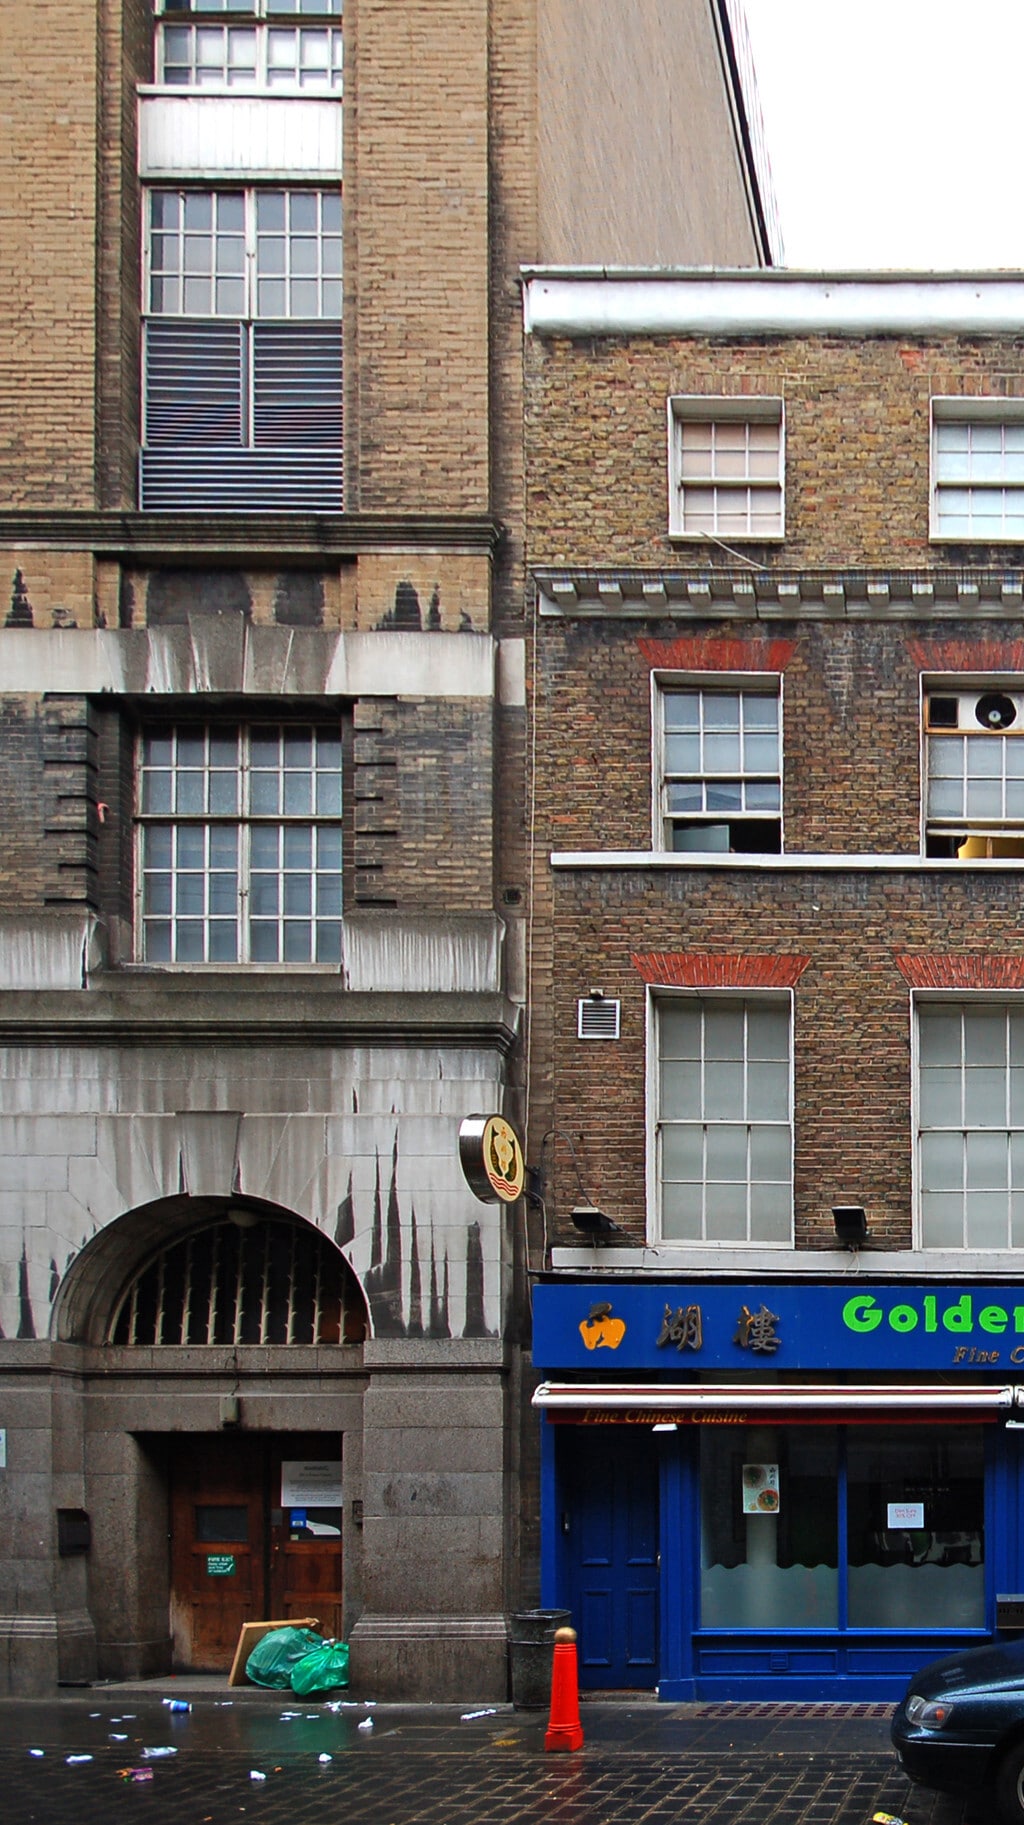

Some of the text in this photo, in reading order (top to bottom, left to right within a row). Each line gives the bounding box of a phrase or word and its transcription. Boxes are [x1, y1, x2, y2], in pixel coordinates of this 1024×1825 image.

[952, 1346, 999, 1364] Fine
[582, 1408, 748, 1423] Fine Chinese Cuisine
